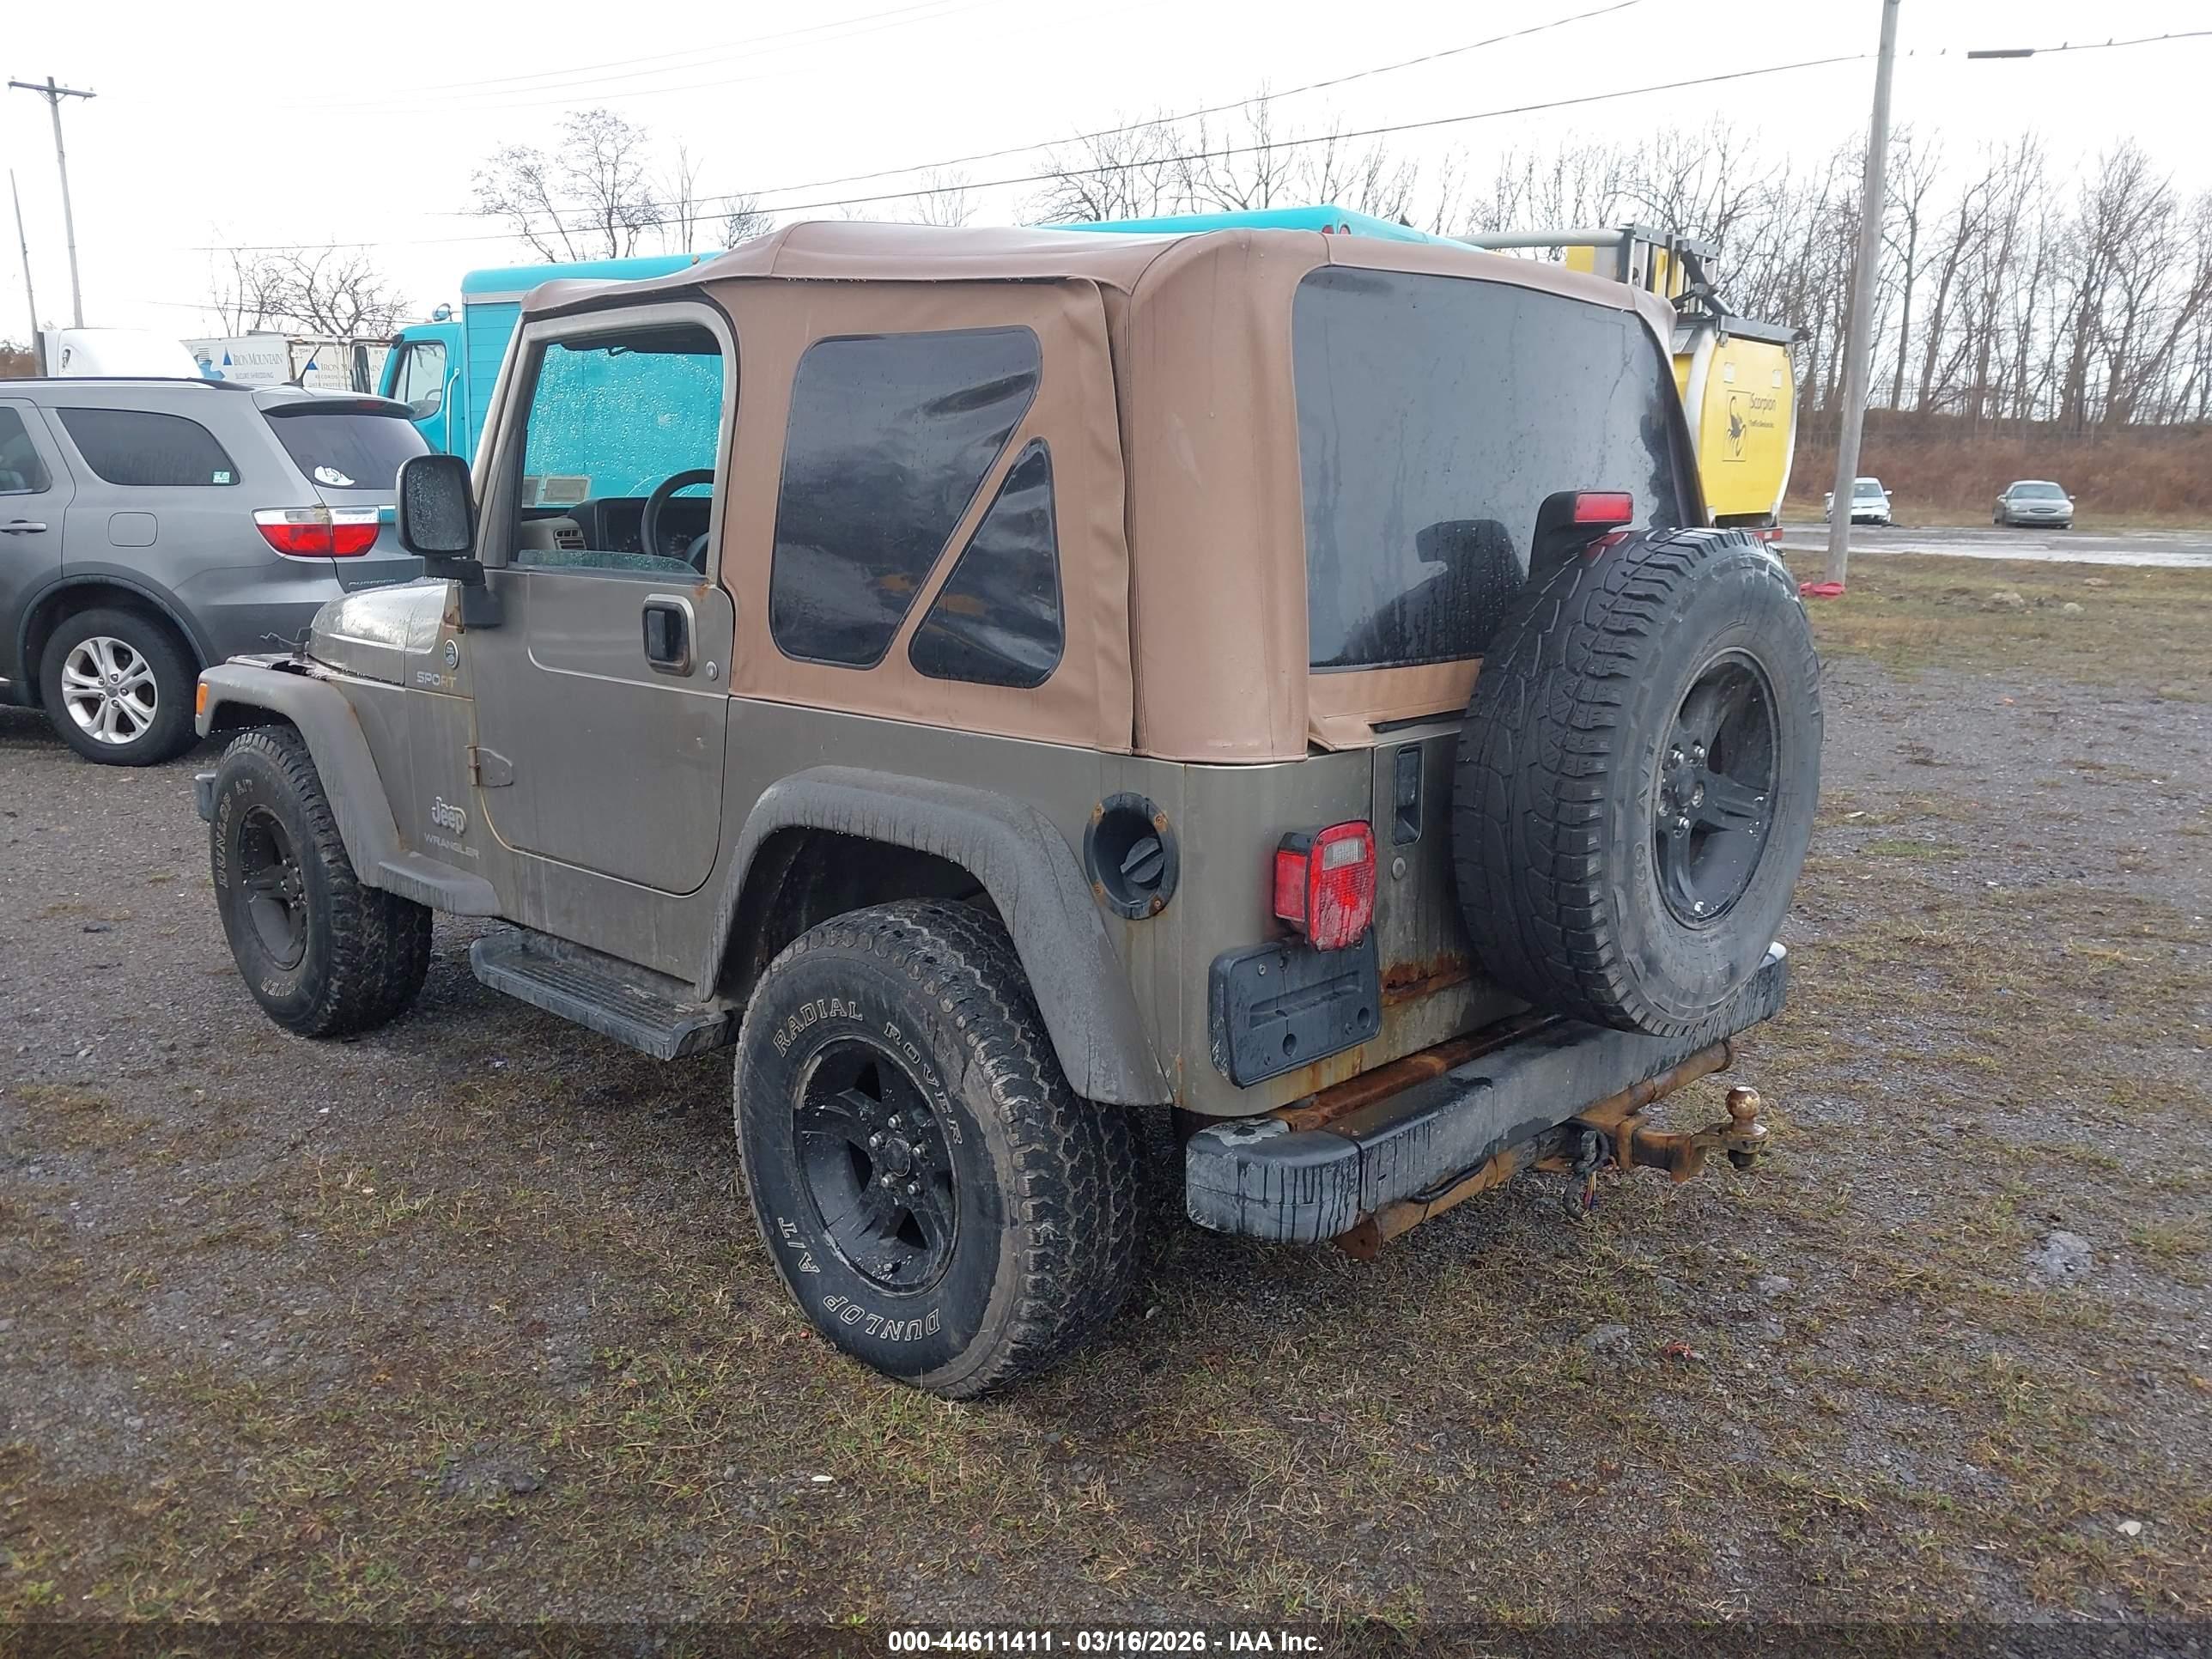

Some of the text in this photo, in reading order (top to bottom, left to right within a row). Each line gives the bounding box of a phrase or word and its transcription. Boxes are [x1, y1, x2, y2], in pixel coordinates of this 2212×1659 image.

[233, 352, 283, 365] IRON MOUNTAIN
[320, 362, 339, 371] IRON
[1750, 392, 1777, 415] Scorpion
[416, 671, 457, 688] SPORT
[431, 796, 467, 835] Jeep
[216, 792, 232, 888] DUNLOP
[424, 831, 480, 860] WRANGLER
[773, 998, 963, 1145] RADIAL ROVER
[776, 1217, 942, 1341] DUNLOP A/T
